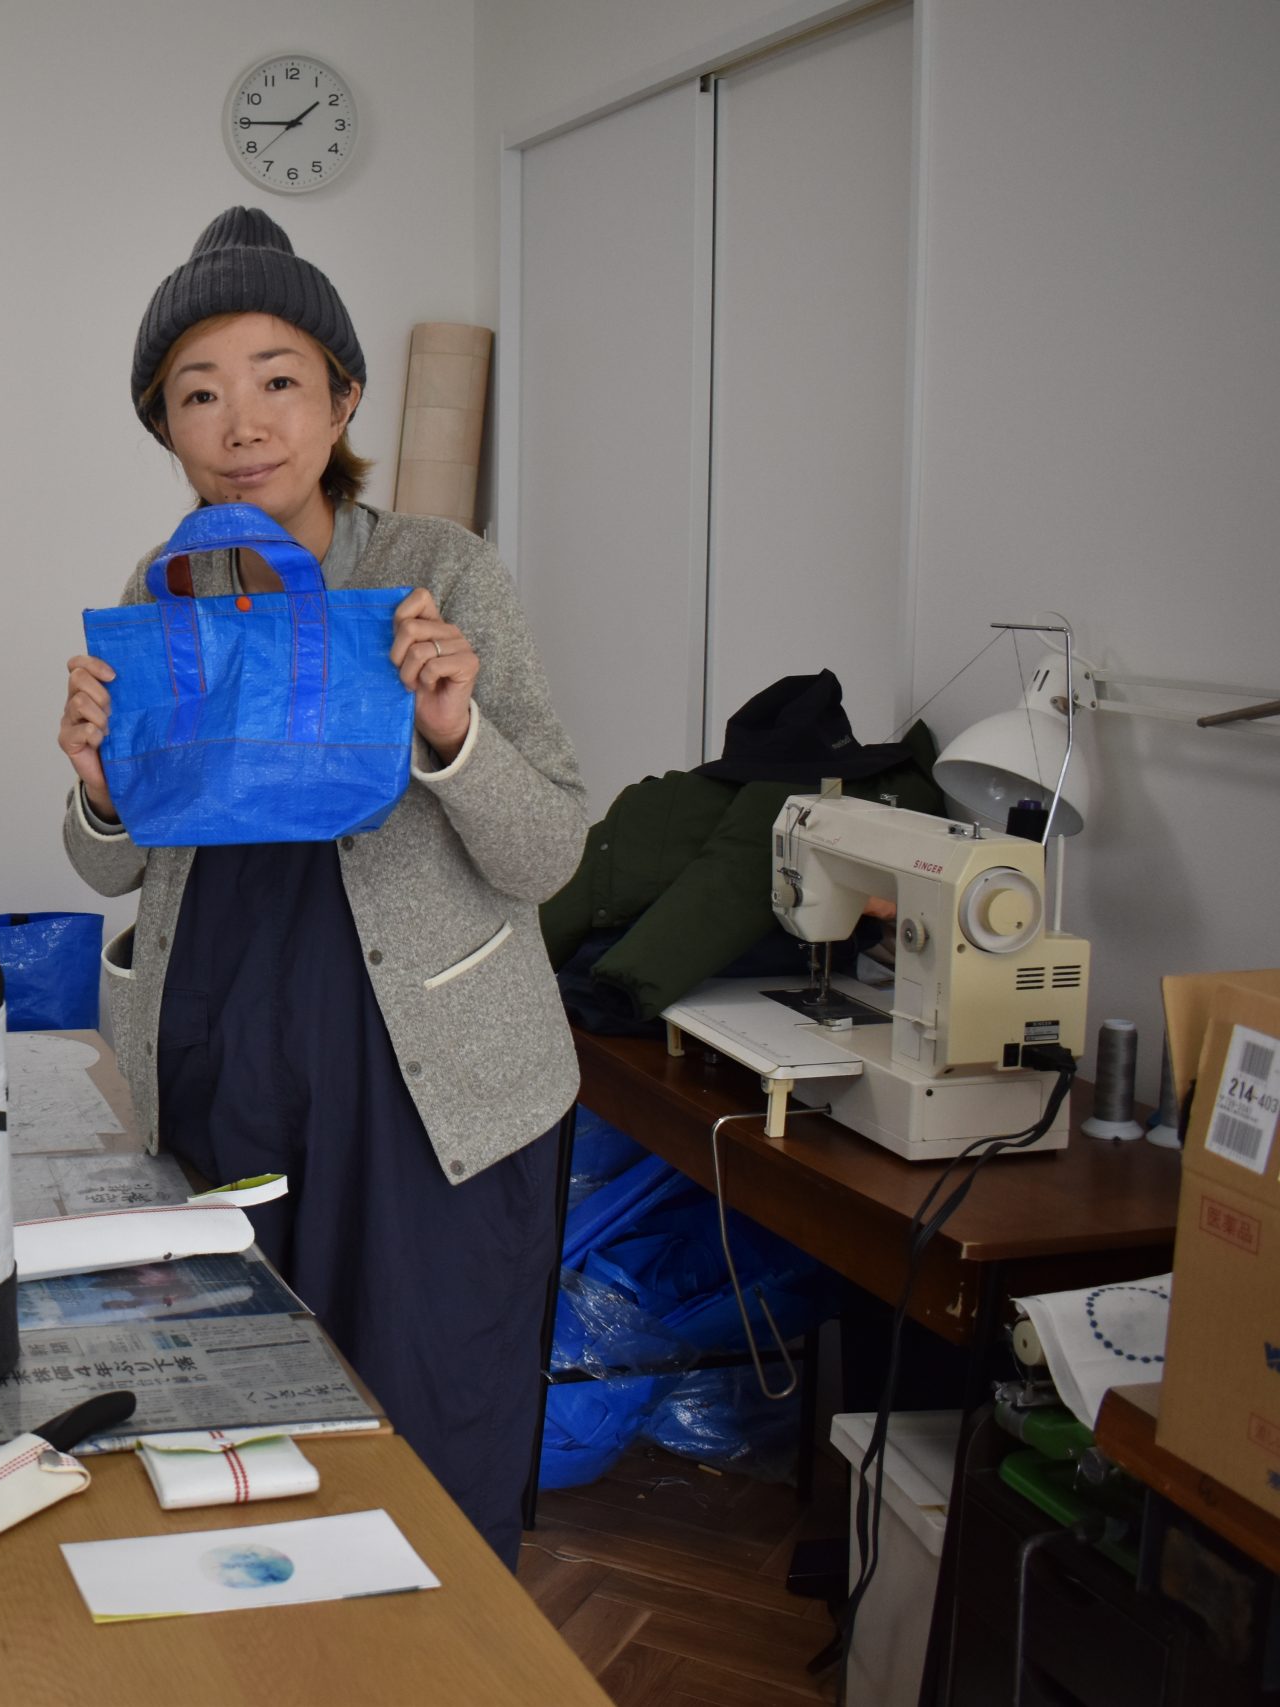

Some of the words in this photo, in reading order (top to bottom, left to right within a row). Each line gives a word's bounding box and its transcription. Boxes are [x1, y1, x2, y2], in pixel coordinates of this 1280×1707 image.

[285, 67, 300, 80] 12
[264, 75, 275, 87] 11
[315, 76, 319, 88] 1
[247, 93, 262, 105] 10
[328, 94, 339, 106] 2
[239, 117, 251, 129] 9
[334, 119, 346, 131] 3
[246, 141, 257, 153] 8
[327, 142, 339, 154] 4
[262, 160, 274, 172] 7
[311, 161, 322, 173] 5
[287, 167, 298, 180] 6
[913, 860, 943, 874] SINGER
